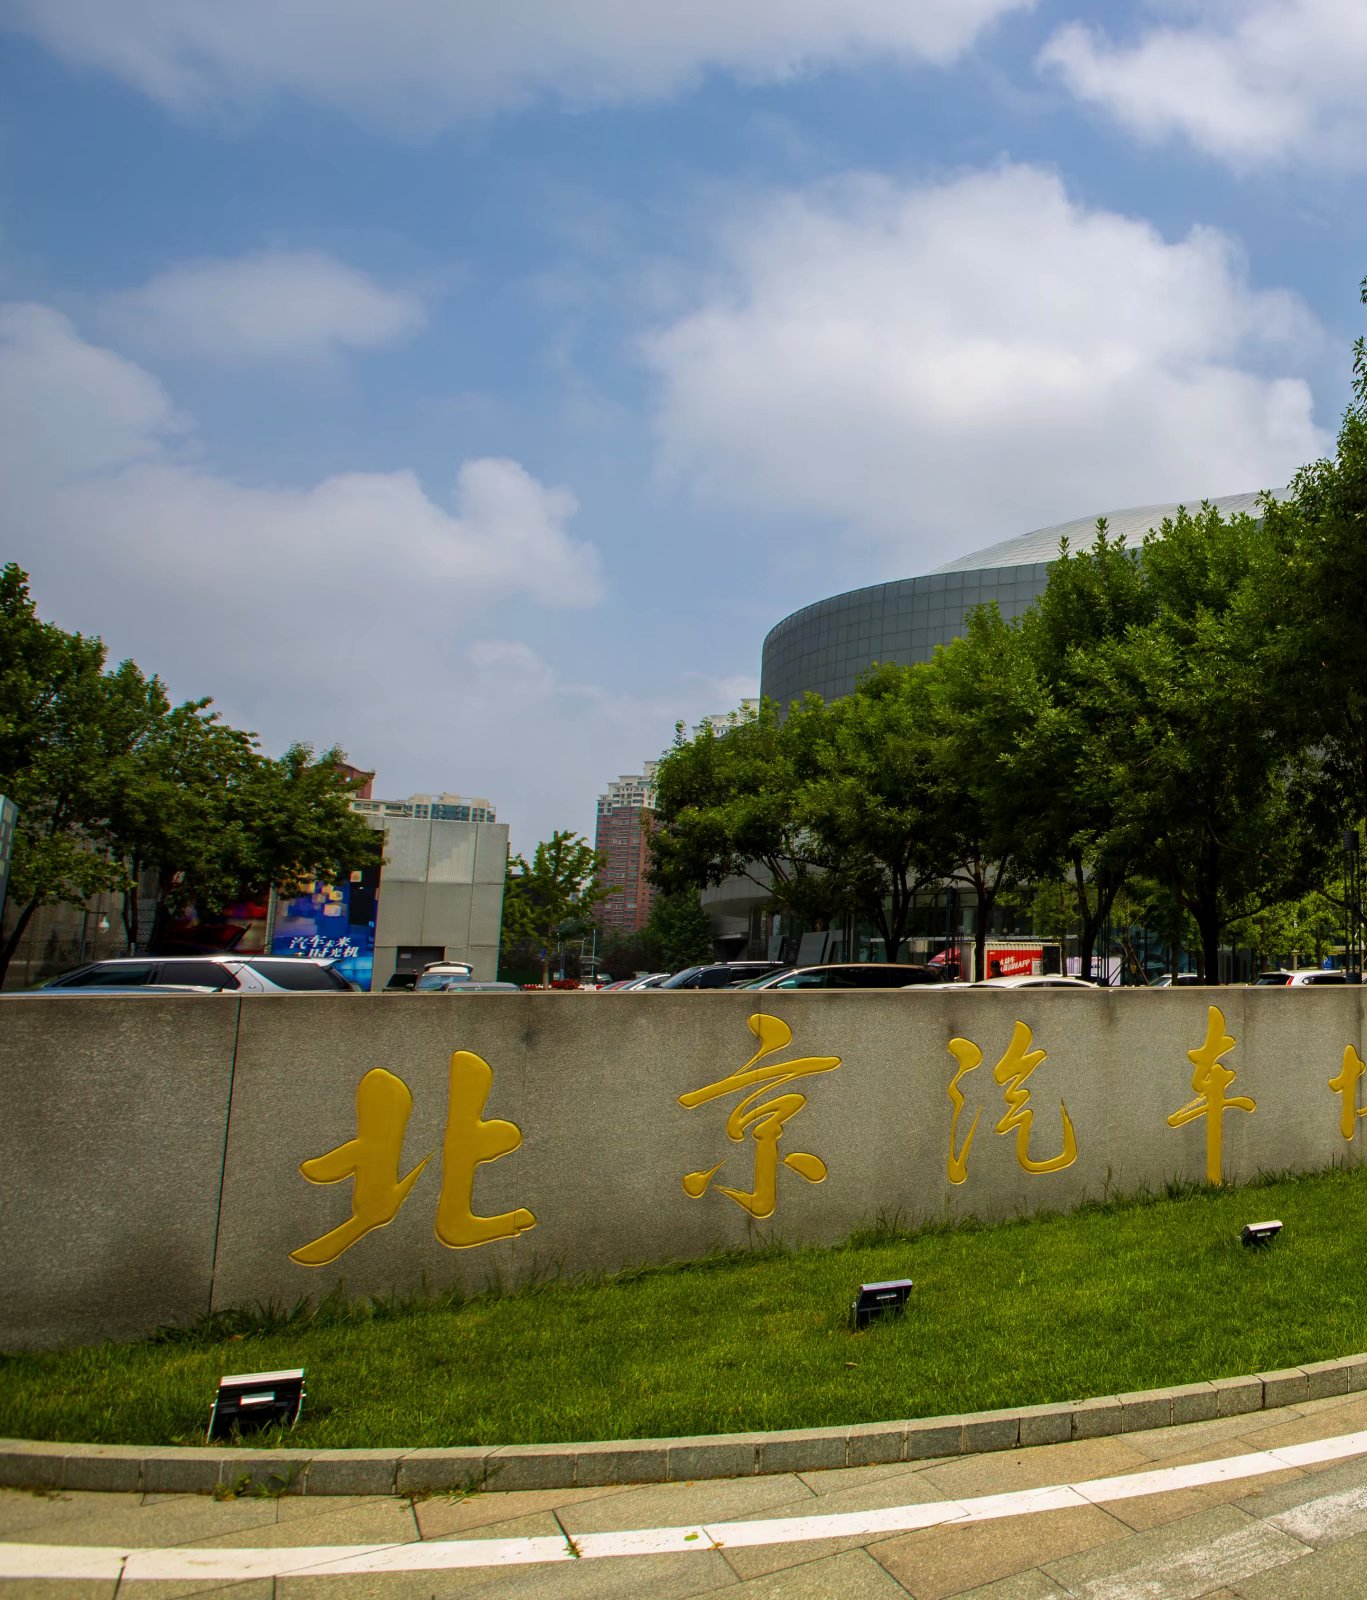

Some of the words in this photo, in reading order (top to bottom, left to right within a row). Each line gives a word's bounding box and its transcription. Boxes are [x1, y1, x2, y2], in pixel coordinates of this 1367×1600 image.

[289, 935, 351, 949] 汽车未来
[308, 946, 359, 958] 时光机
